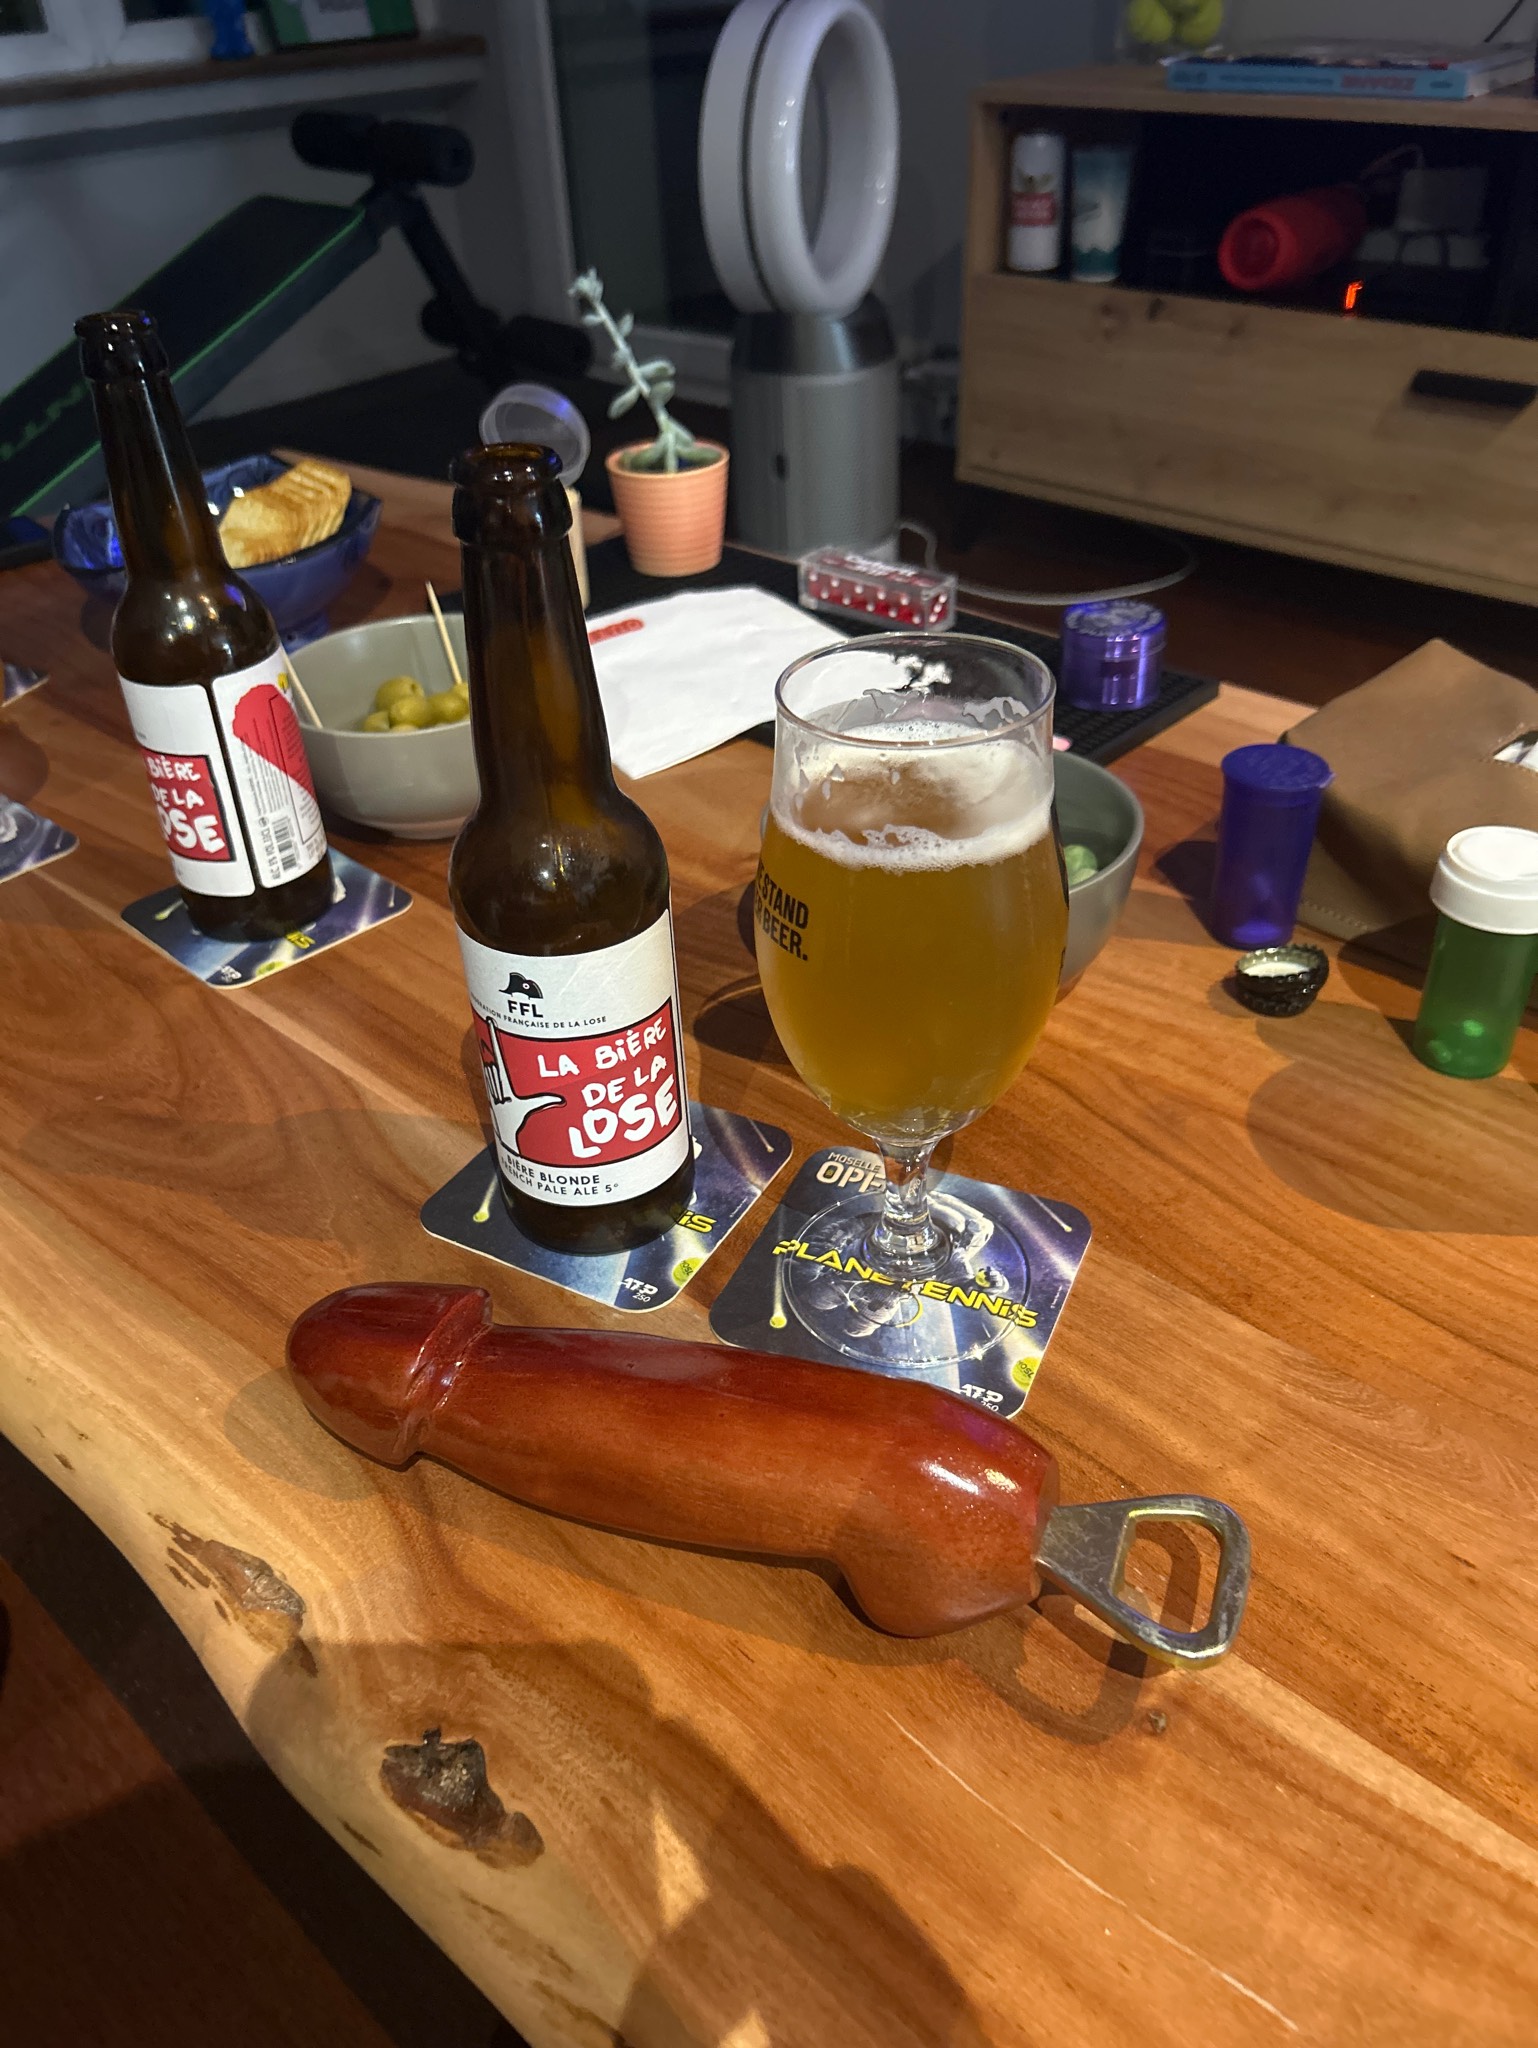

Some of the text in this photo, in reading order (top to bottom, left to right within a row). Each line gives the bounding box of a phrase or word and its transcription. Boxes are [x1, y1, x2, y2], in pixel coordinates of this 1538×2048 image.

[171, 788, 205, 810] LA
[156, 802, 226, 854] OSE
[762, 872, 809, 930] STAND
[507, 999, 544, 1018] FFL
[503, 1014, 550, 1029] FRANÇAISE
[568, 1020, 580, 1028] LA
[583, 1016, 607, 1026] LOSE
[537, 1054, 580, 1078] LA
[581, 1055, 667, 1108] DE LA
[568, 1073, 678, 1159] LOSE
[506, 1154, 600, 1186] BIÈRE BLONDE
[827, 1152, 882, 1172] MOSELLE
[537, 1182, 567, 1195] PALE
[573, 1186, 599, 1196] ALE
[616, 1277, 659, 1295] ATP
[632, 1292, 652, 1303] 250
[958, 1383, 1004, 1403] ATP
